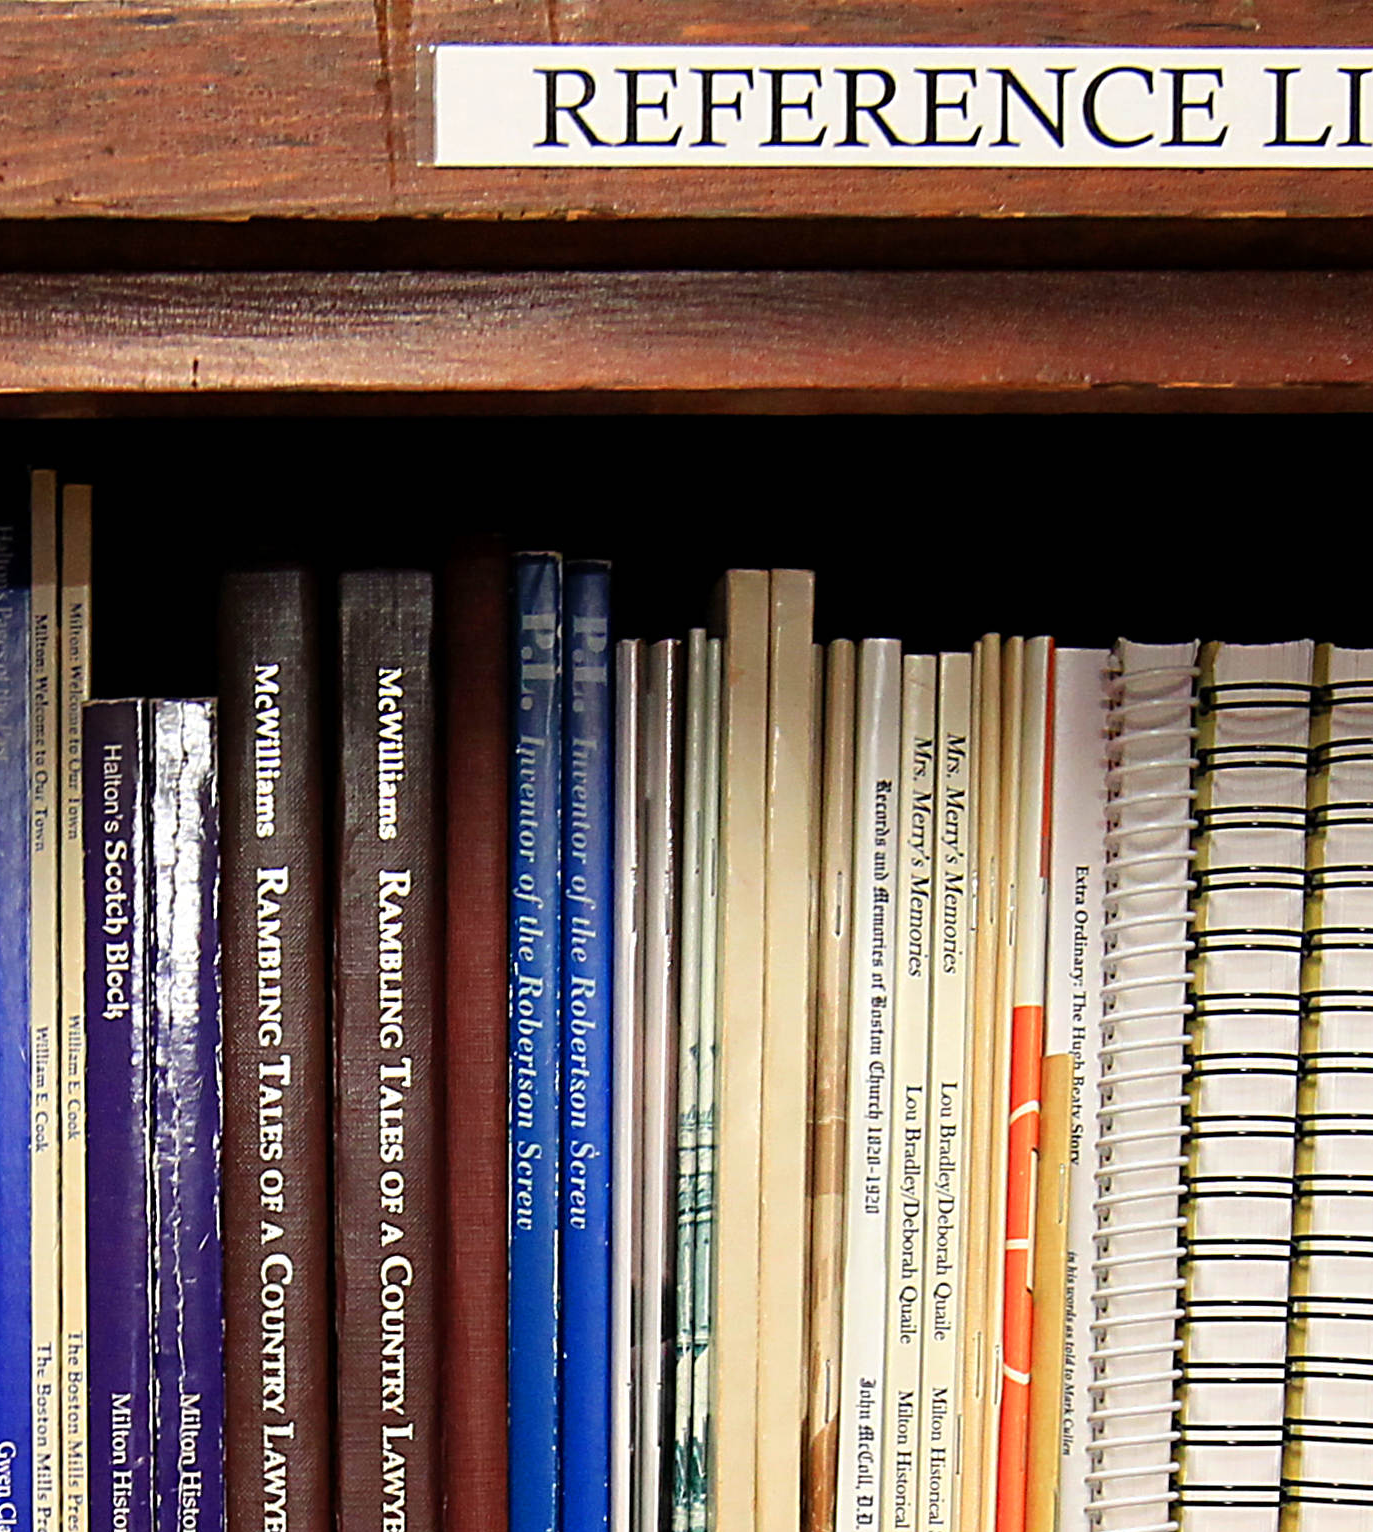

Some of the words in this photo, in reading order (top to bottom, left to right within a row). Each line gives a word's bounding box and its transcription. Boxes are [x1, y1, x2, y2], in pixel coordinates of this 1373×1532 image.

[533, 66, 1227, 150] REFERENCE
[102, 744, 126, 831] Halton's
[378, 668, 403, 840] McWilliams
[946, 733, 965, 777] Mrs.
[943, 785, 965, 863] Merry's
[102, 839, 128, 932] Scotch
[943, 871, 962, 973] Memories
[102, 942, 128, 1019] Block
[378, 869, 411, 1048] RAMBLING
[380, 1058, 411, 1162] TALES
[939, 1083, 957, 1118] Lou
[381, 1170, 404, 1213] OF
[381, 1222, 404, 1246] A
[933, 1124, 957, 1275] Bradley/Deborah
[380, 1255, 413, 1415] COUNTRY
[931, 1283, 952, 1340] Quaile
